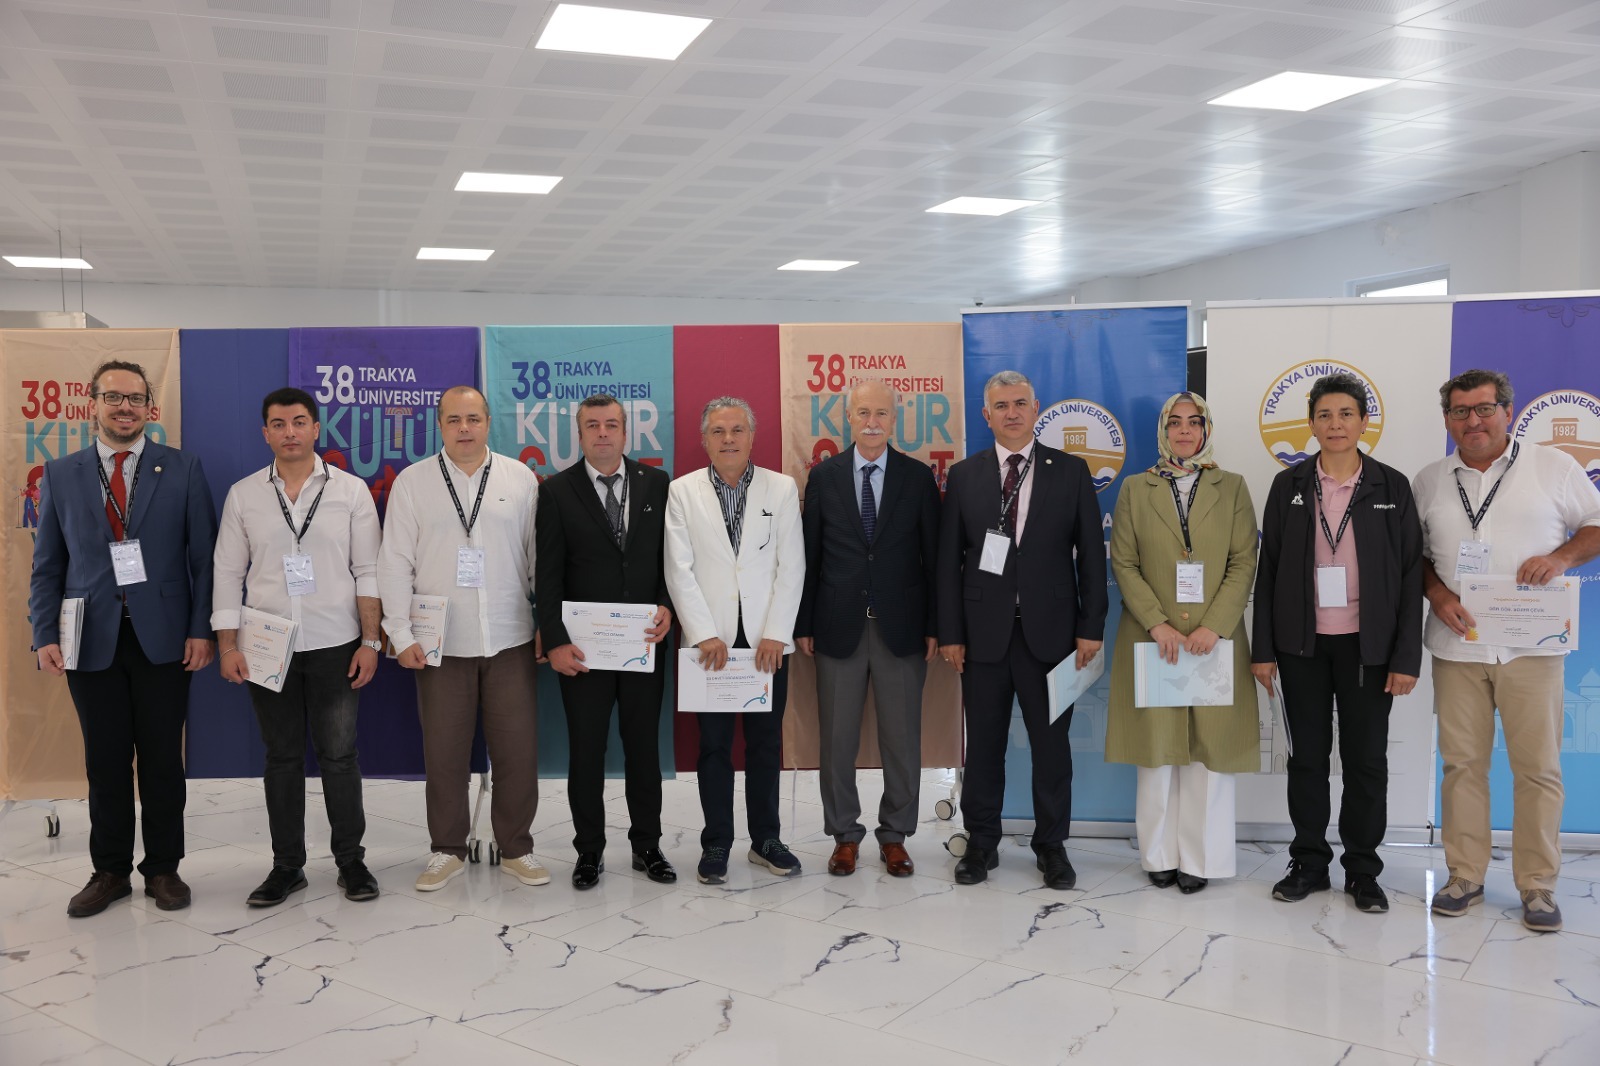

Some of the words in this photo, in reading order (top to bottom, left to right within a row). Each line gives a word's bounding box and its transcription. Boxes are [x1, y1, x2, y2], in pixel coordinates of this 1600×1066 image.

[554, 361, 612, 376] TRAKYA
[849, 355, 907, 370] TRAKYA
[358, 367, 417, 382] TRAKYA
[358, 388, 441, 406] ÜNİVERSİTE
[555, 382, 651, 400] ÜNİVERSİTESİ
[1264, 371, 1304, 416] TRAKYA
[1034, 409, 1060, 437] AKYA
[1060, 402, 1124, 447] ÜNİVERSİTESİ
[1515, 400, 1550, 438] TRAKYA
[1554, 425, 1576, 437] 1982
[1064, 434, 1086, 446] 1982
